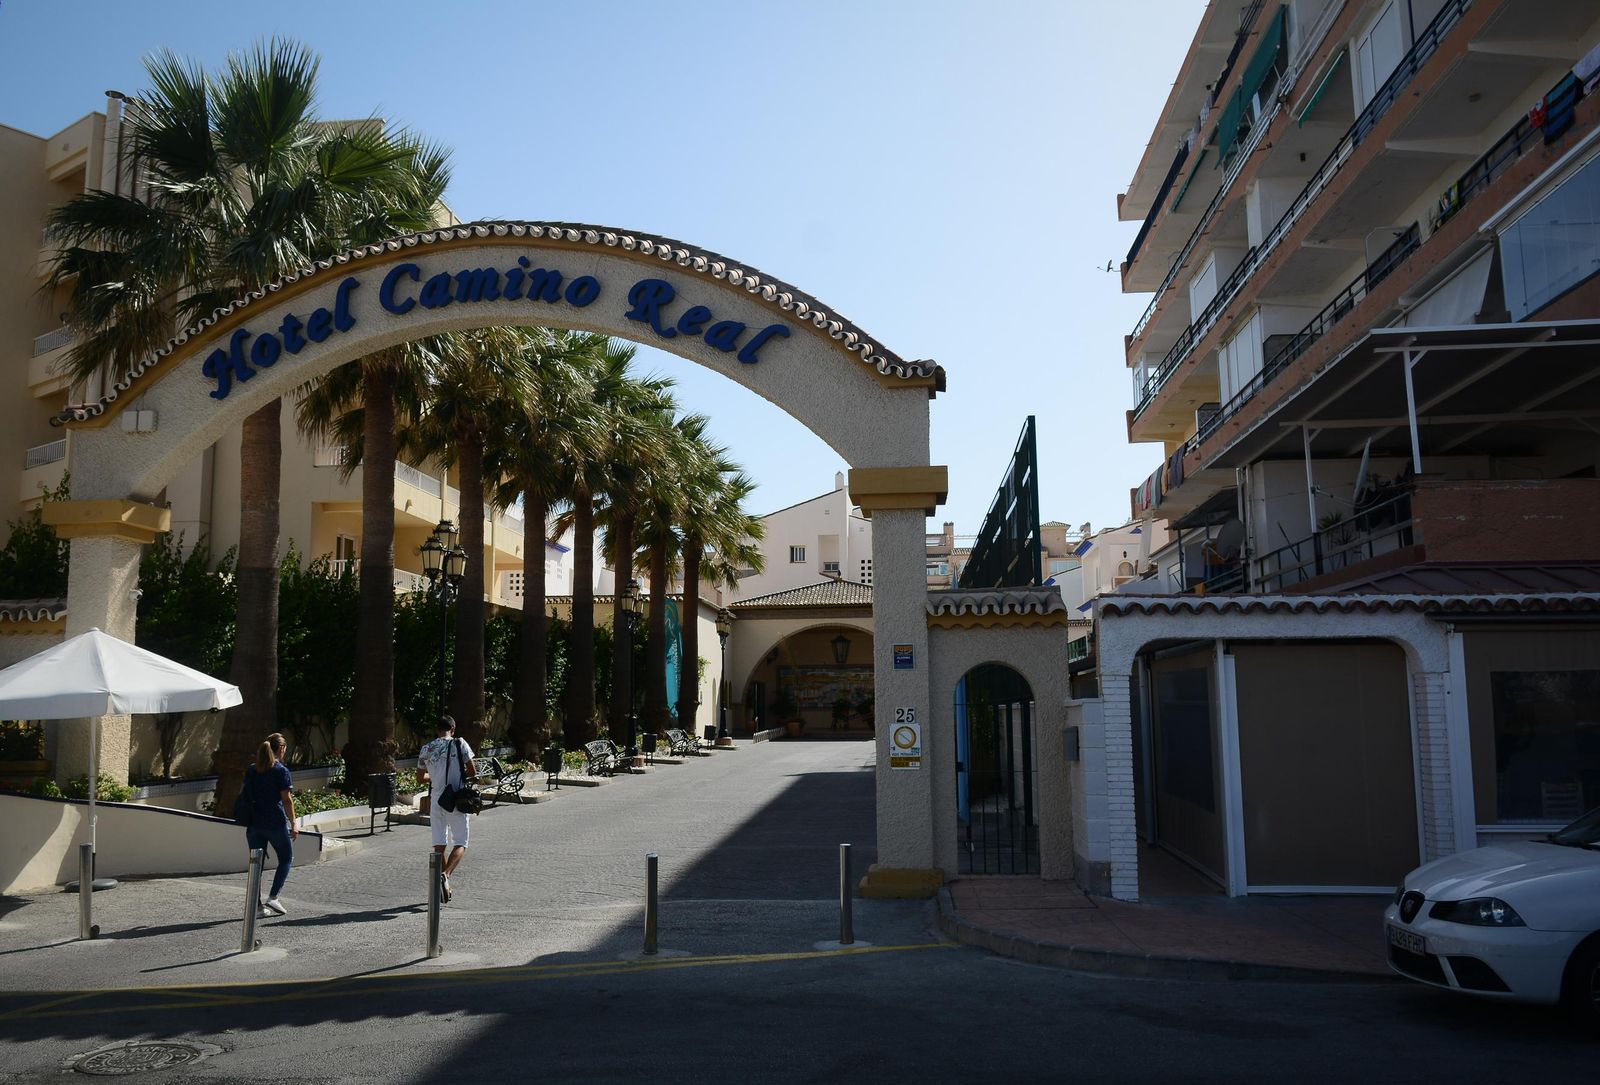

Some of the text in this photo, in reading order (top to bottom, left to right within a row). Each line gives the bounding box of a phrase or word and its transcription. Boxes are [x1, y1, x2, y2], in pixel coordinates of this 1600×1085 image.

[203, 256, 790, 399] Hotel Camino Real
[896, 708, 915, 723] 25
